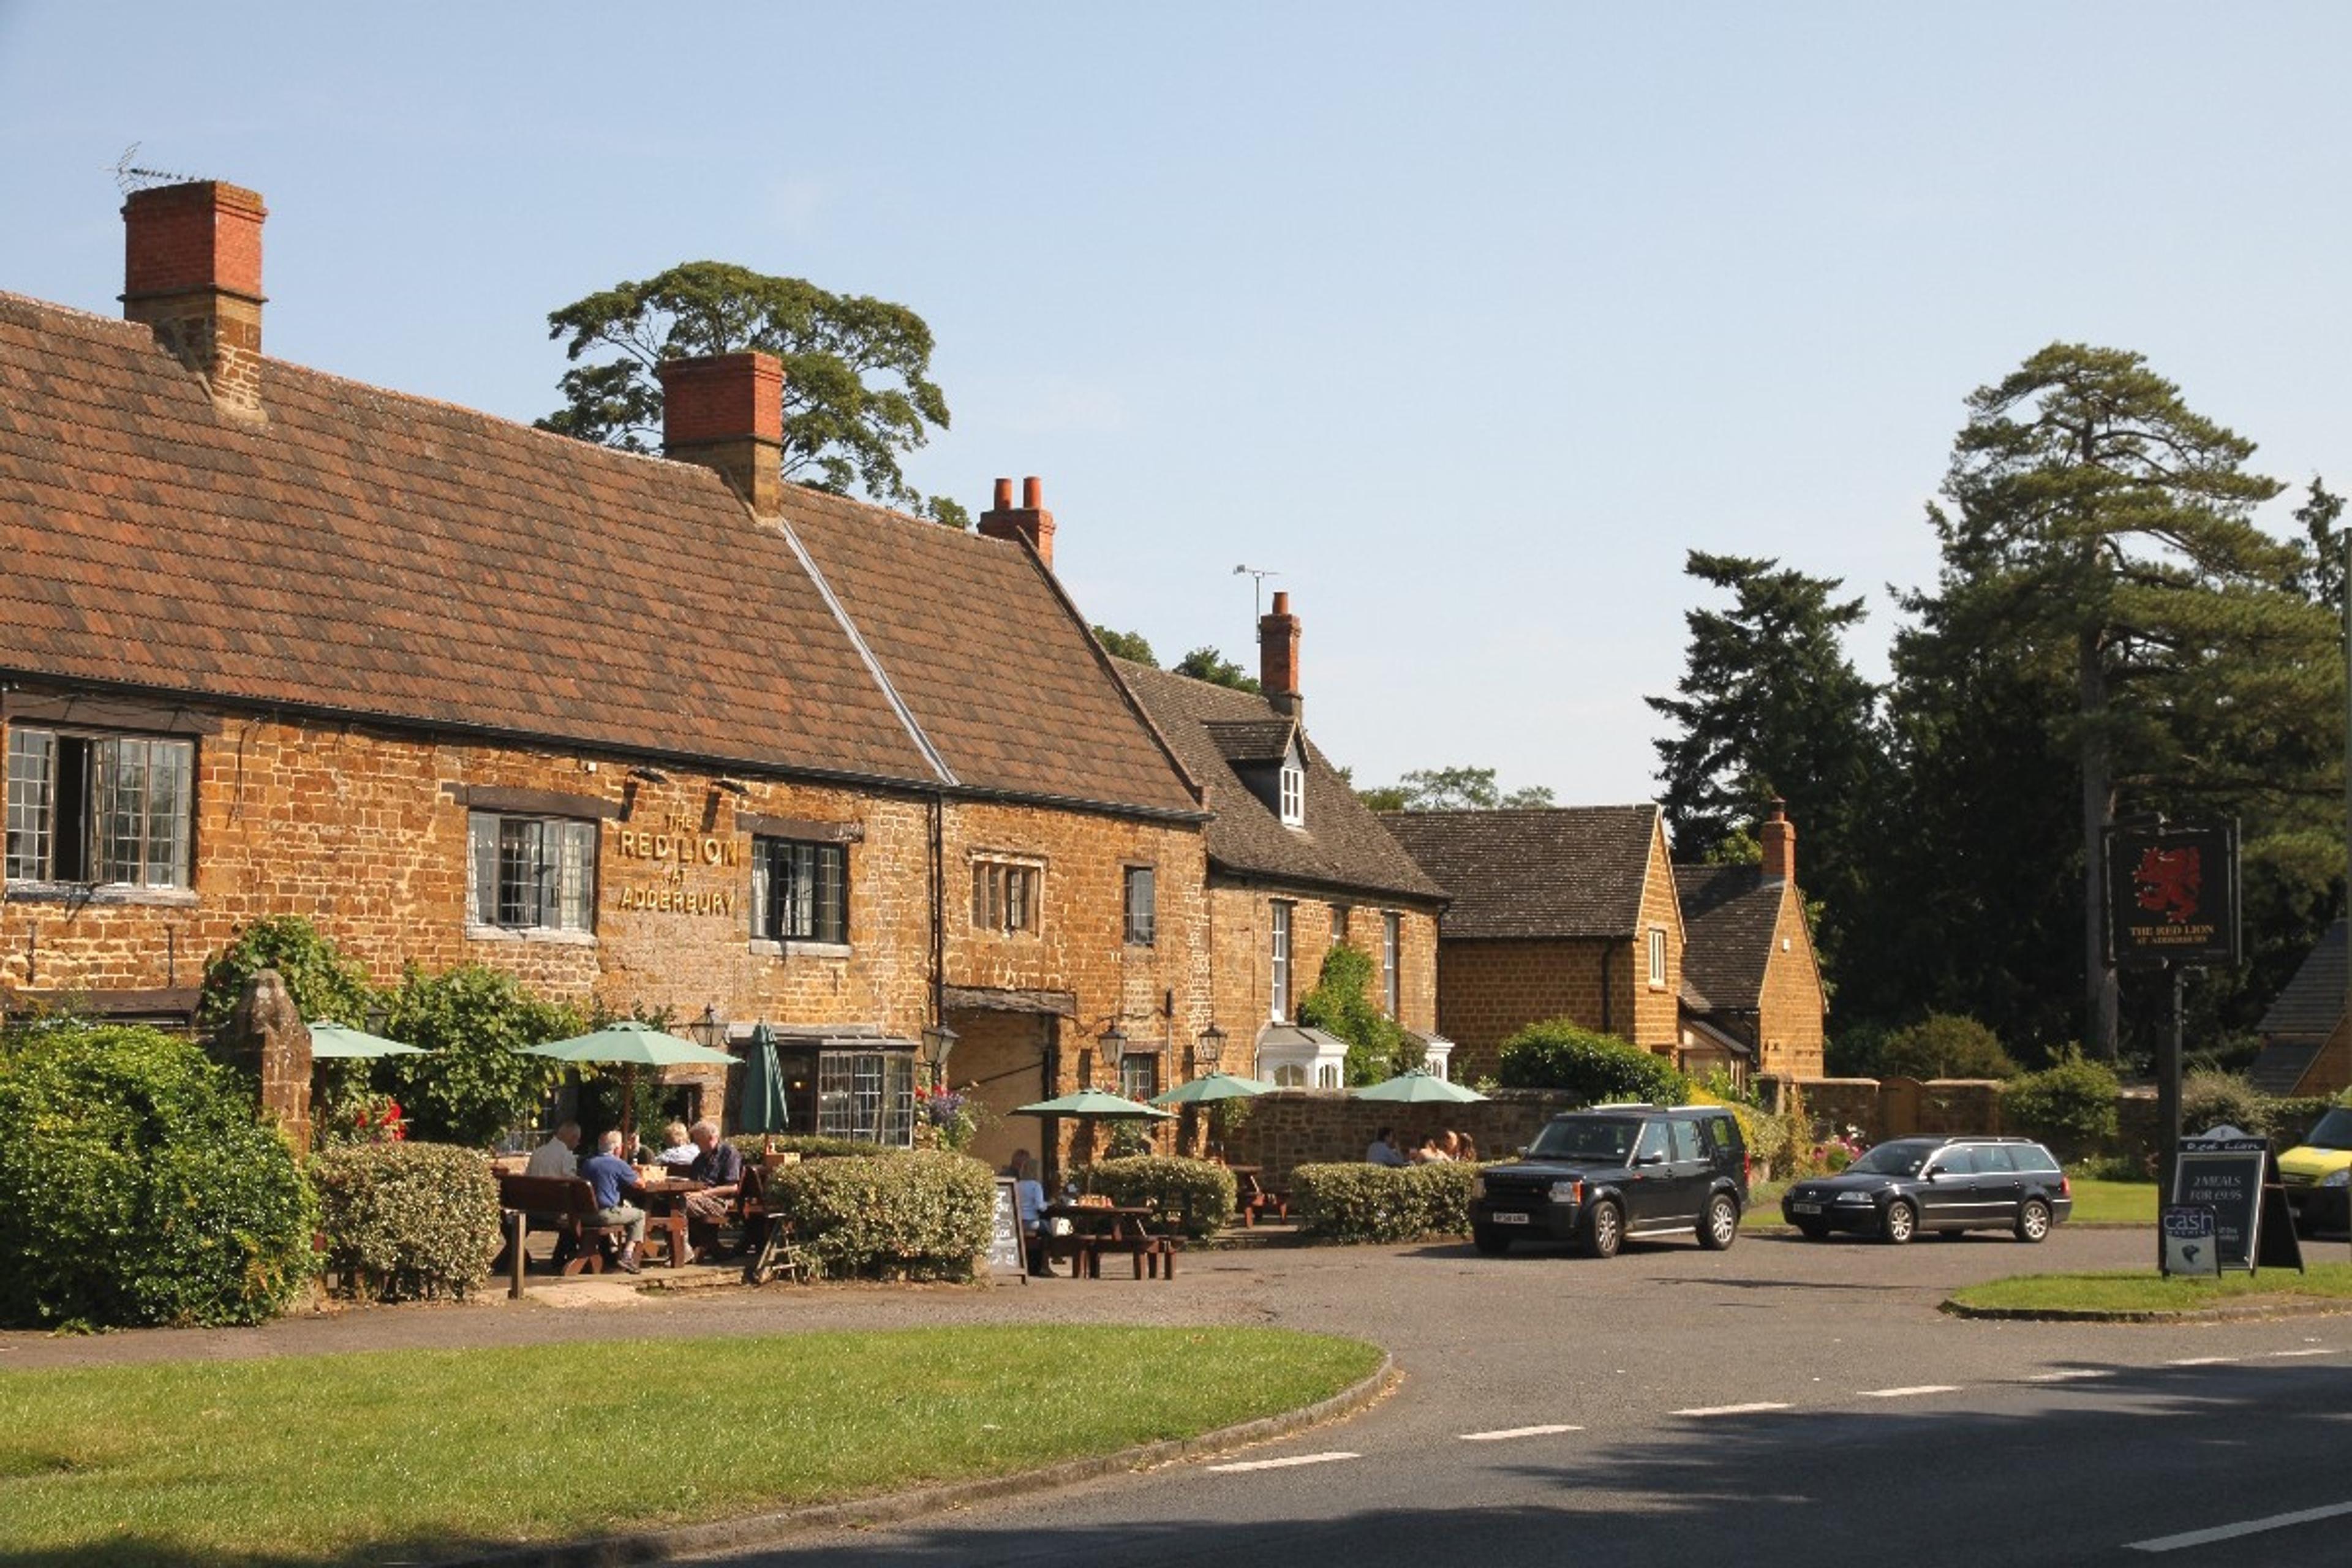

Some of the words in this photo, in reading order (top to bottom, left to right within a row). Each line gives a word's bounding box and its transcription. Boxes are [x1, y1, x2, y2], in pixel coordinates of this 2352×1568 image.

[667, 813, 693, 828] THE
[620, 831, 668, 858] RED
[674, 837, 739, 867] LION
[620, 887, 735, 914] ADDERBURY
[2130, 926, 2152, 936] THE
[2155, 925, 2182, 936] RED
[2185, 924, 2214, 935] LION
[2201, 1175, 2242, 1187] MEALS
[2189, 1189, 2212, 1201] FOR
[2163, 1212, 2214, 1230] cash
